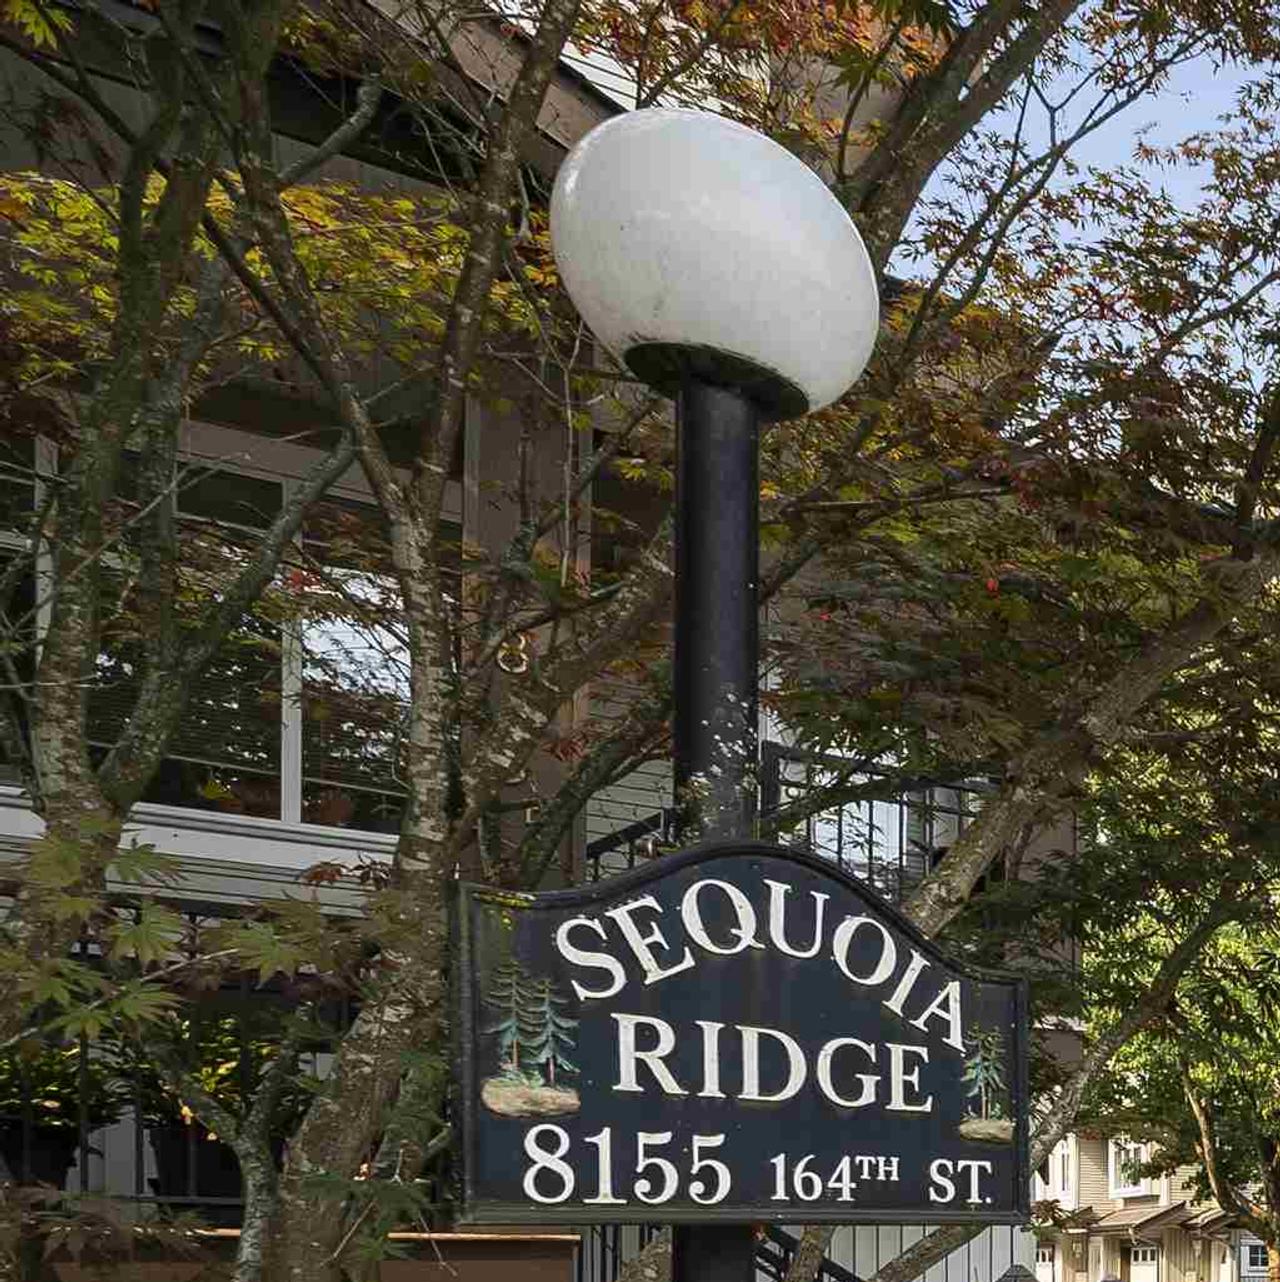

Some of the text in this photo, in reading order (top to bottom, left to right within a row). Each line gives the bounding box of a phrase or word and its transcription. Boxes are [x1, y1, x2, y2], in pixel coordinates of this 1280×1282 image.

[555, 878, 966, 1054] SEQUOIA
[610, 1013, 933, 1112] RIDGE
[522, 1124, 992, 1204] 8155 164TH ST.
